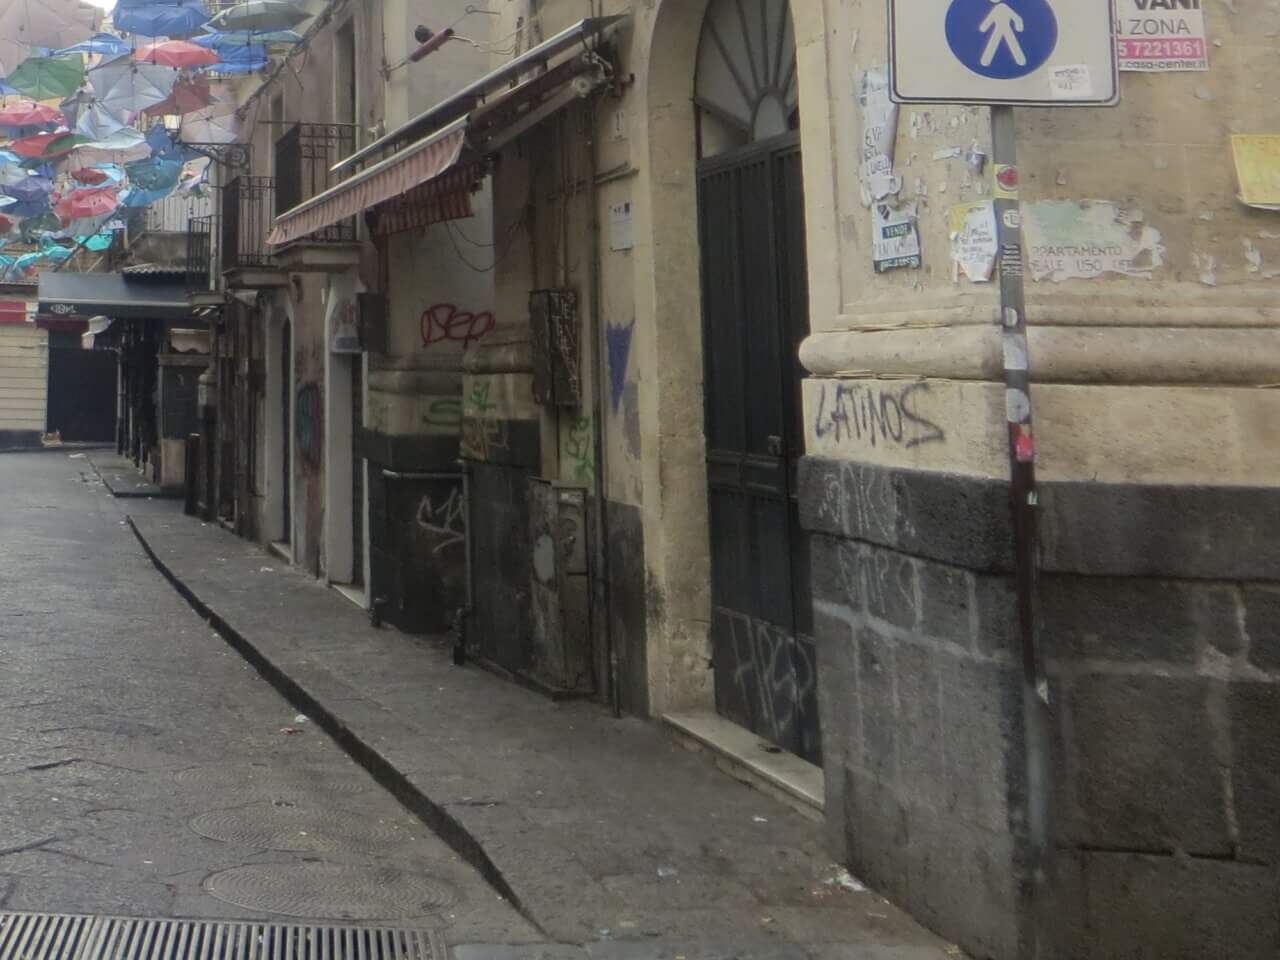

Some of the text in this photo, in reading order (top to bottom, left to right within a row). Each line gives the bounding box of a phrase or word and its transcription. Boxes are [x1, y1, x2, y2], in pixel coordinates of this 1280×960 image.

[1128, 18, 1191, 35] ZONA
[1132, 41, 1201, 57] 7221361
[815, 382, 945, 449] LATINOS
